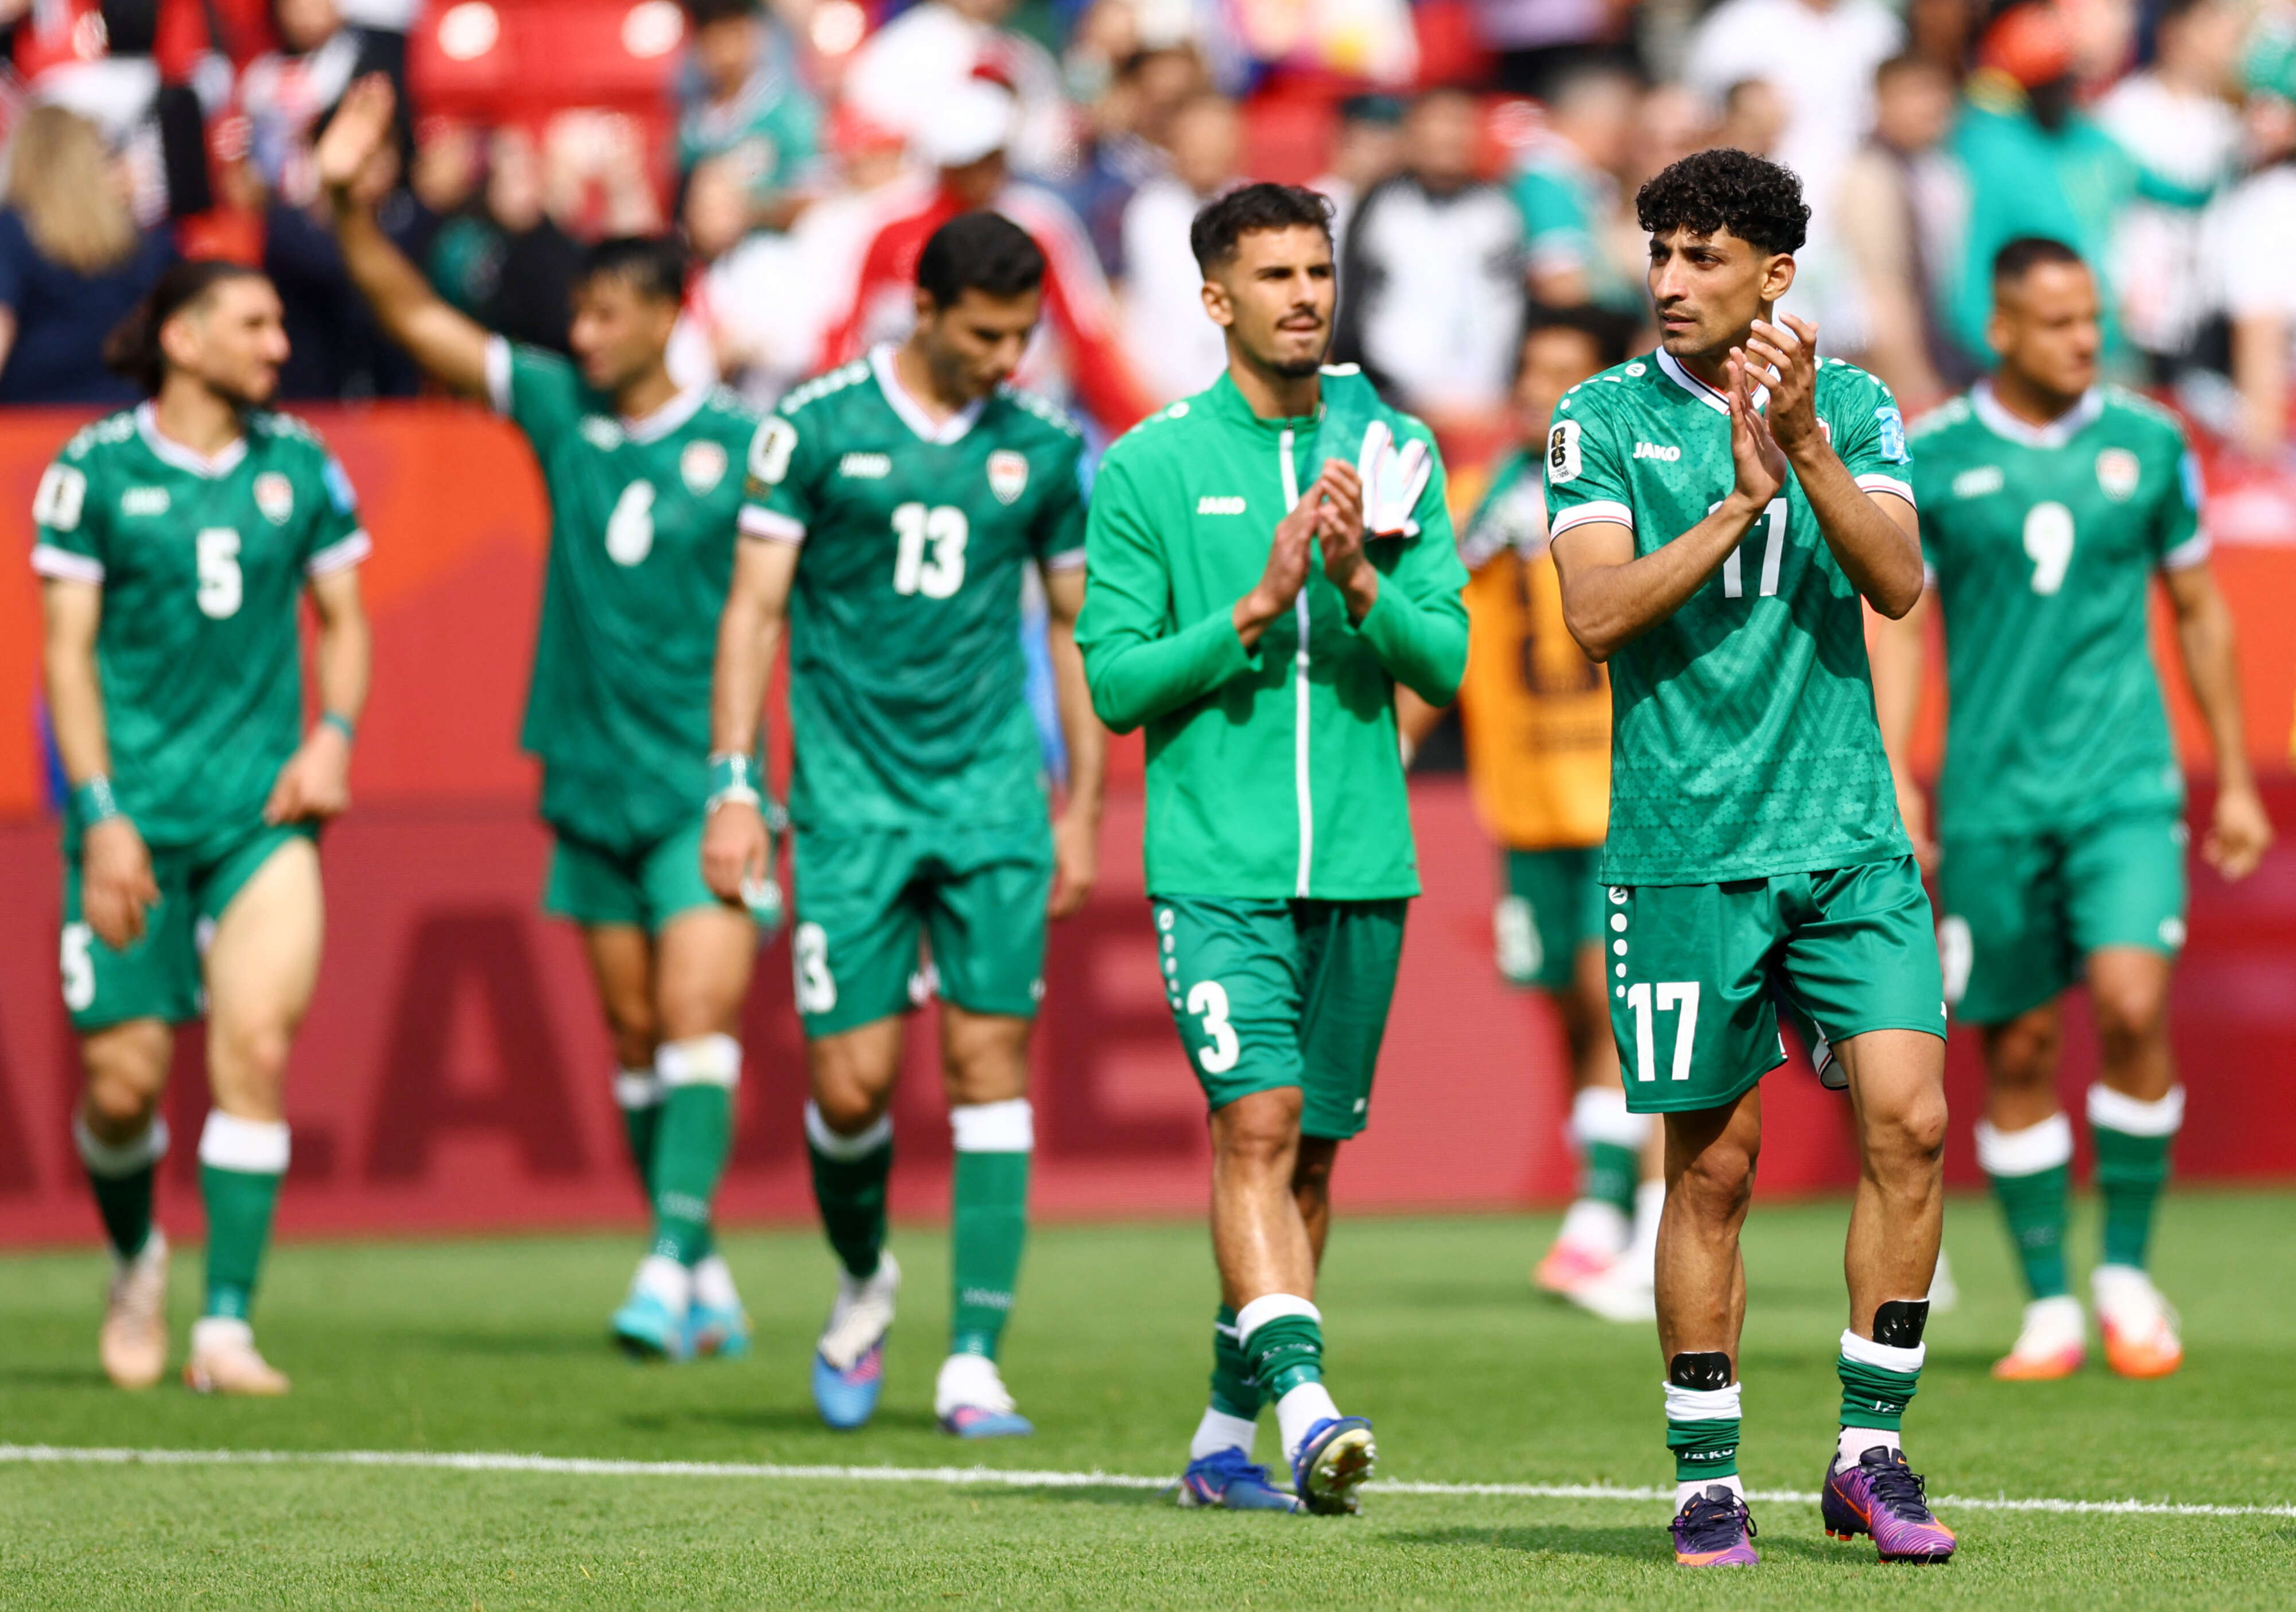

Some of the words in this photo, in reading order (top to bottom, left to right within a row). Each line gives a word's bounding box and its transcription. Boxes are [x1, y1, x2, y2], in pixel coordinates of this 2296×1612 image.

[1632, 442, 1681, 461] JAKO
[606, 480, 655, 566] 6
[892, 503, 968, 598] 13
[1197, 496, 1246, 515] JAKO
[1708, 498, 1787, 598] 17
[2023, 502, 2073, 595] 9
[196, 527, 242, 619] 5
[60, 922, 95, 1011] 5
[1186, 980, 1239, 1073] 3
[1628, 982, 1699, 1082] 17
